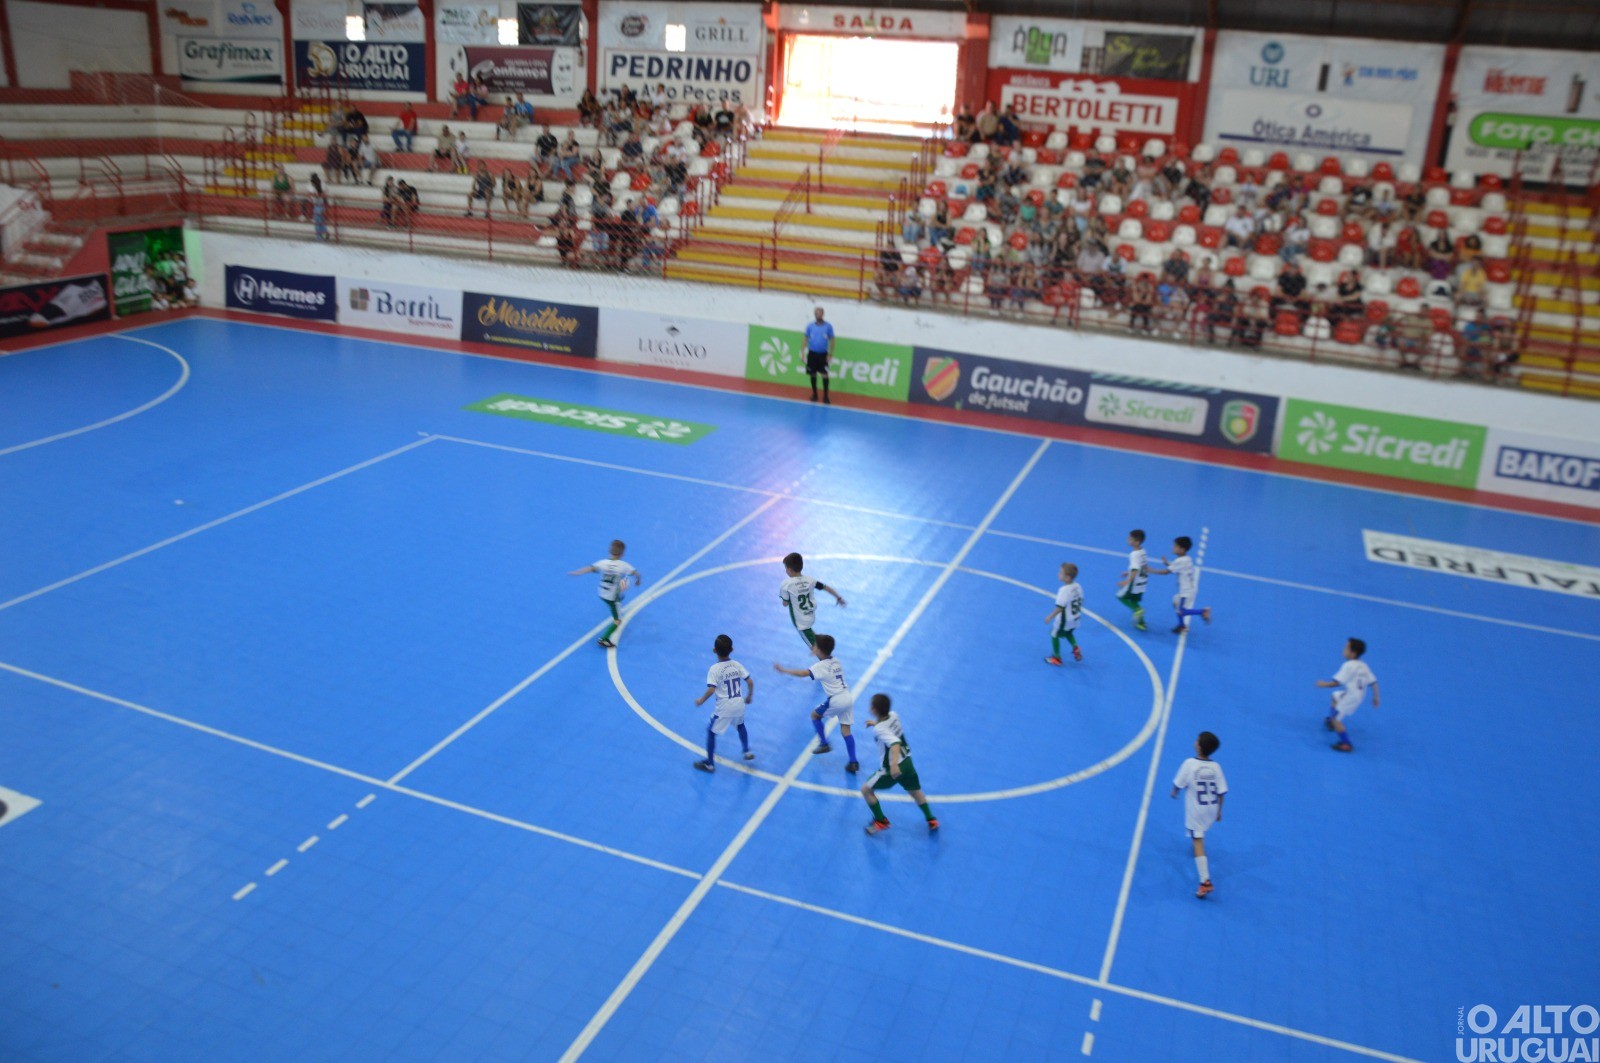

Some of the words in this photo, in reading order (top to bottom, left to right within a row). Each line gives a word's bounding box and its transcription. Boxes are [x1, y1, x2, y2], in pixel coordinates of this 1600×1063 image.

[695, 26, 750, 43] GRILL
[834, 14, 913, 31] SADA
[184, 40, 274, 69] Grafimax
[345, 43, 361, 63] O
[362, 43, 409, 65] ALTO
[339, 62, 410, 81] URUGUAI
[611, 53, 751, 83] PEDRINHO
[1250, 65, 1290, 88] URI
[1012, 93, 1162, 126] BERTOLETTI
[1252, 118, 1297, 139] Ótica
[1302, 123, 1372, 147] América
[1480, 120, 1555, 143] FOTO
[259, 280, 327, 306] Hermes
[478, 296, 580, 335] Marathon
[637, 336, 709, 361] LUGANO
[798, 347, 900, 388] credi
[970, 365, 1083, 407] Gauchão
[968, 391, 984, 405] de
[984, 393, 1030, 414] futsal
[1124, 399, 1196, 424] Sicredi
[1342, 423, 1471, 470] Sicredi
[1500, 448, 1600, 488] BAKOF
[797, 592, 814, 611] 21
[723, 677, 742, 699] 10
[1197, 781, 1218, 805] 23
